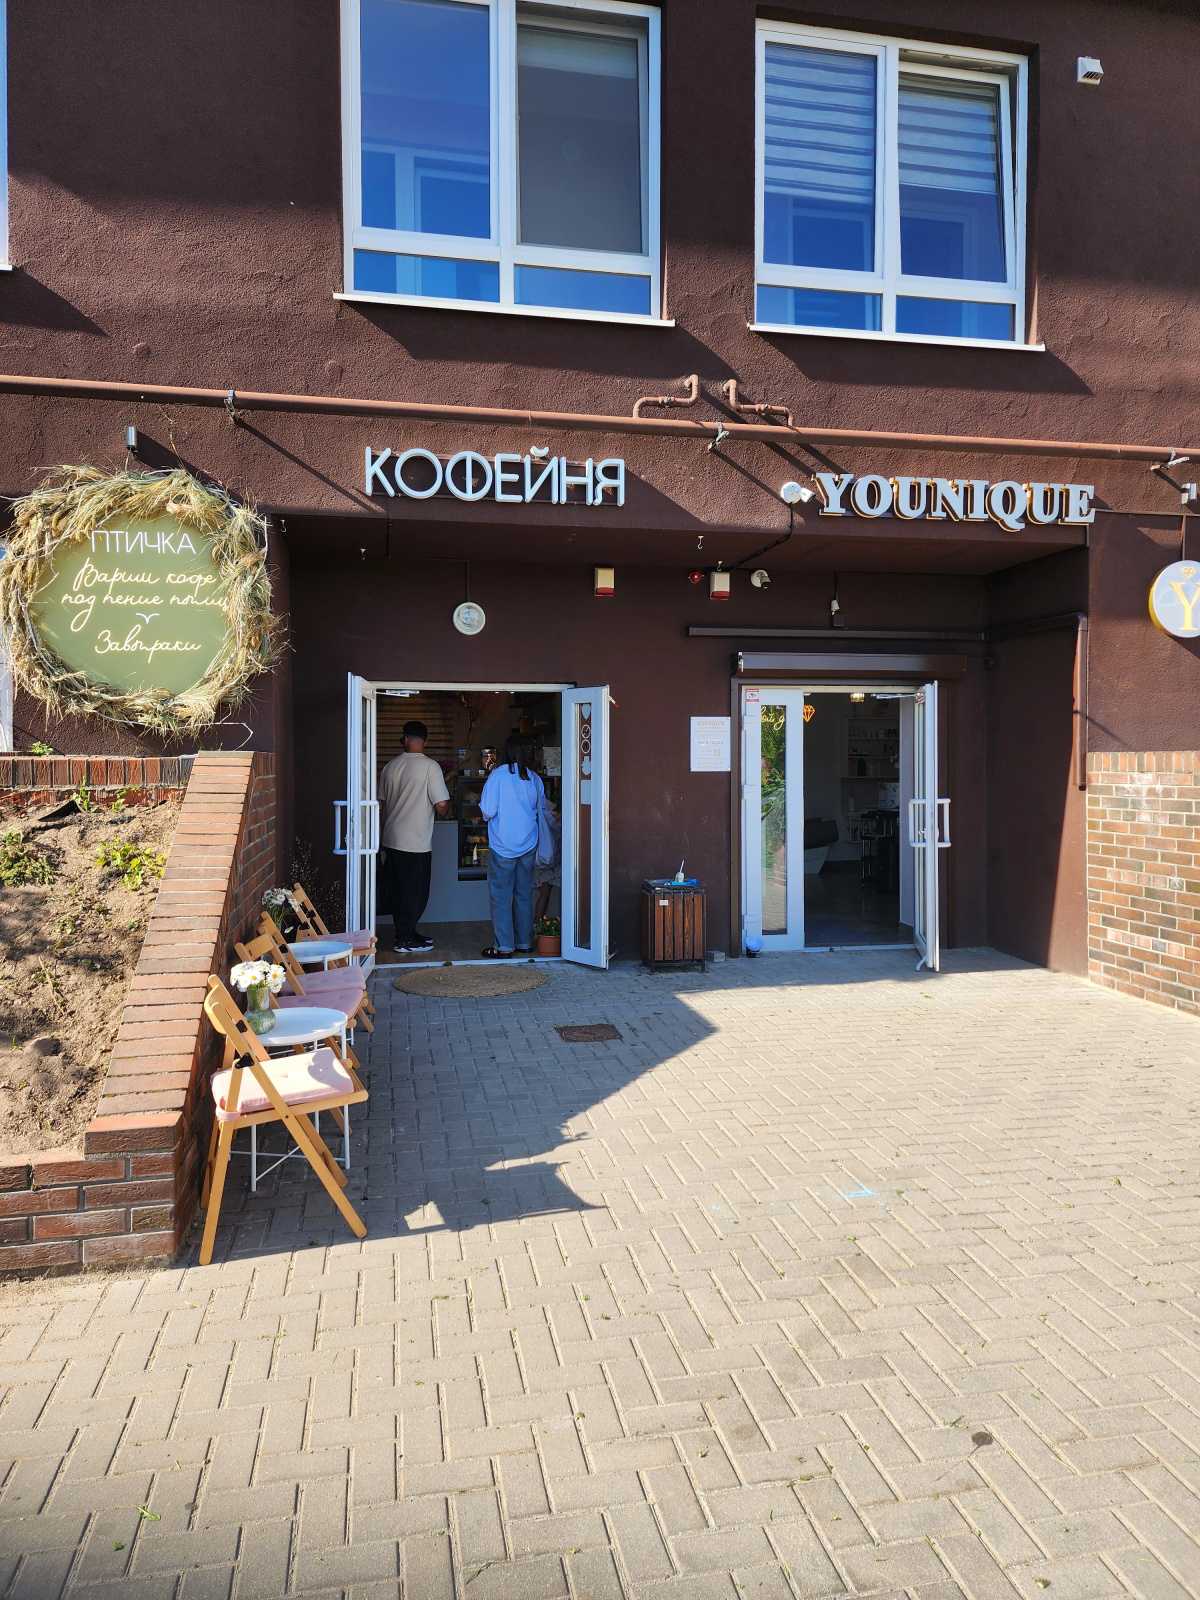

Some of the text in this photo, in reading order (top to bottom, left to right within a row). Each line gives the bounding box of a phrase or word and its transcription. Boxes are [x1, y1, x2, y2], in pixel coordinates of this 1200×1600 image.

[365, 445, 625, 507] КОФЕЙНЯ
[812, 472, 1096, 532] YOUNIQUE
[91, 530, 197, 555] ПТИЧКА
[73, 557, 218, 597] Варим кофе
[61, 593, 230, 633] под пение птиц
[1168, 581, 1200, 631] Y
[95, 624, 202, 663] Завтраки
